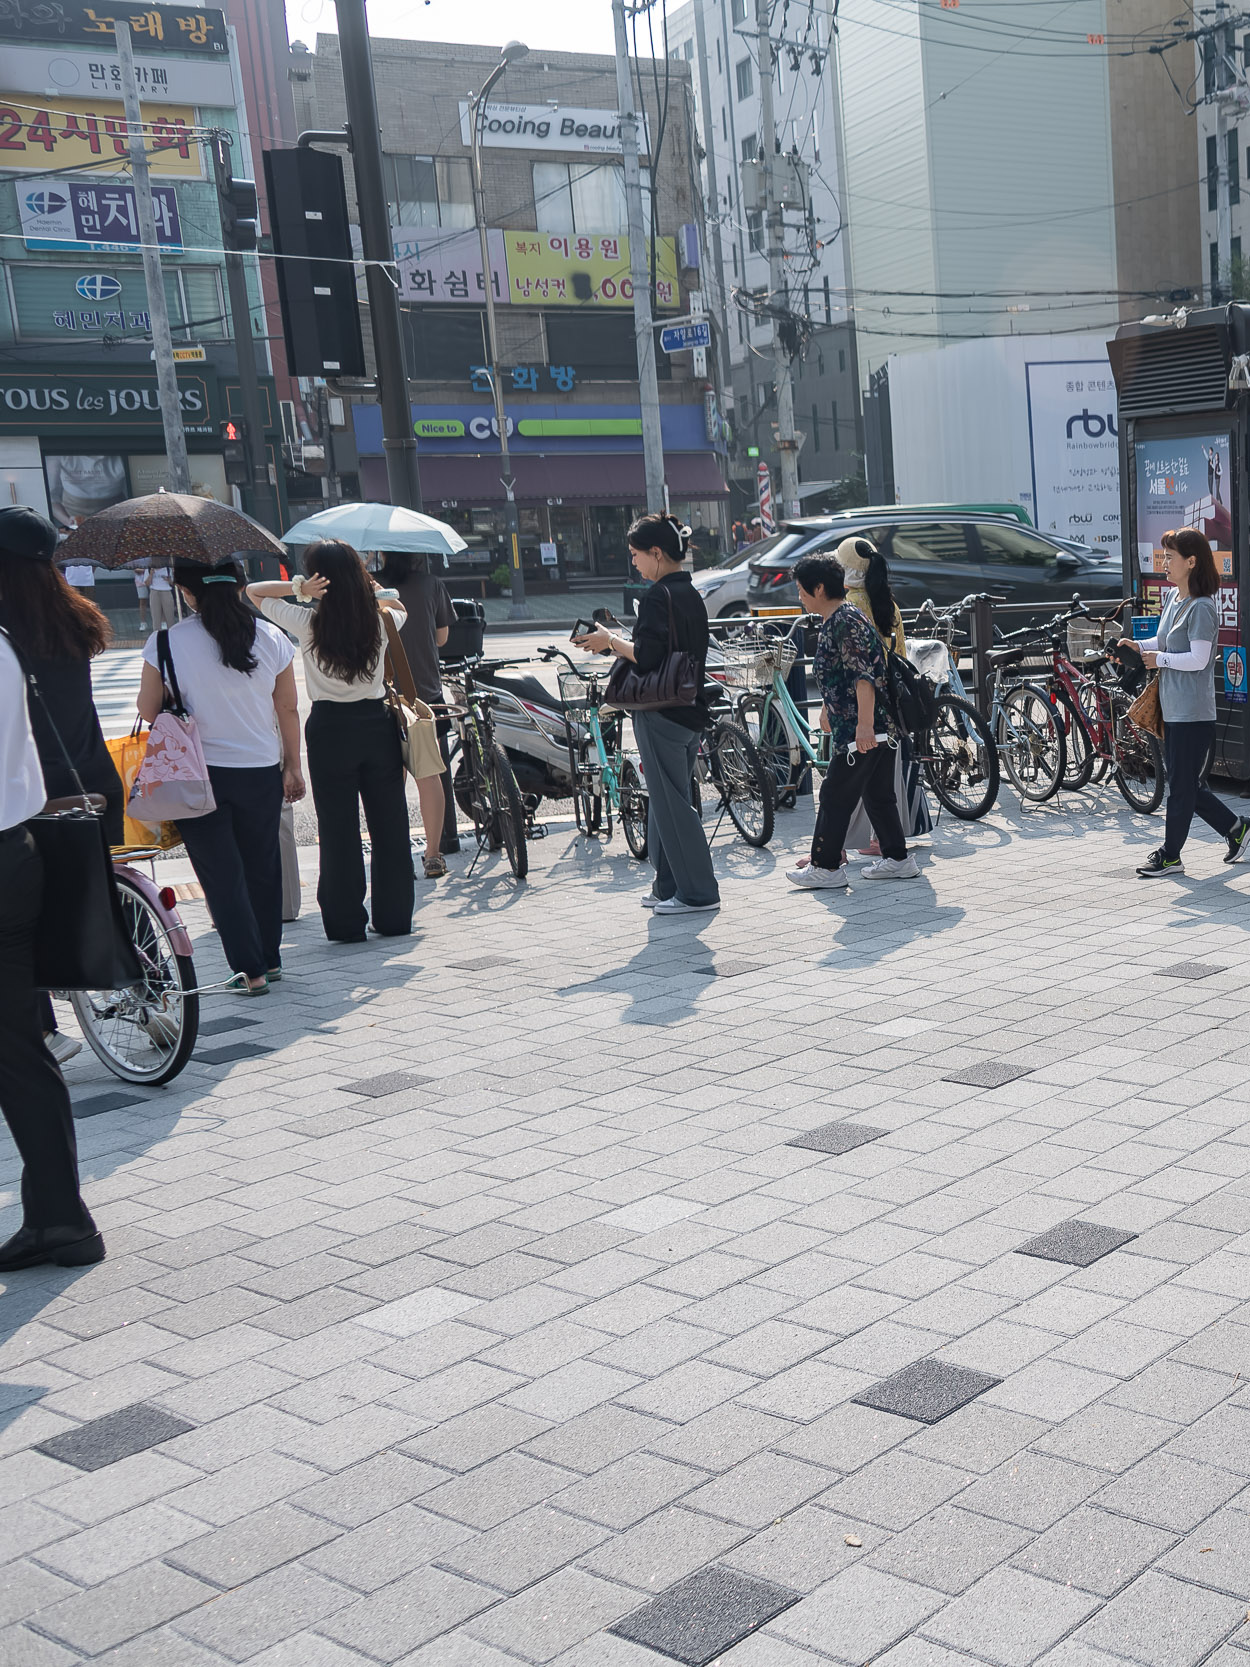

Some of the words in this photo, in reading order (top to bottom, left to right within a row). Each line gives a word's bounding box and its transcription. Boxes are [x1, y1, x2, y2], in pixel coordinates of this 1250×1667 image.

[82, 8, 214, 44] 노래방
[91, 83, 168, 94] LIBARY
[476, 112, 551, 139] Cooing
[560, 117, 639, 140] Beaut
[515, 241, 541, 256] 복지
[549, 237, 620, 260] 이용원
[515, 277, 567, 298] 남성컷
[52, 310, 151, 331] 혜민치과
[1065, 381, 1084, 392] 종합
[1087, 380, 1115, 392] 콘텐츠
[77, 387, 104, 410] les
[421, 423, 441, 435] Nice
[443, 423, 457, 434] to
[469, 416, 514, 440] CU
